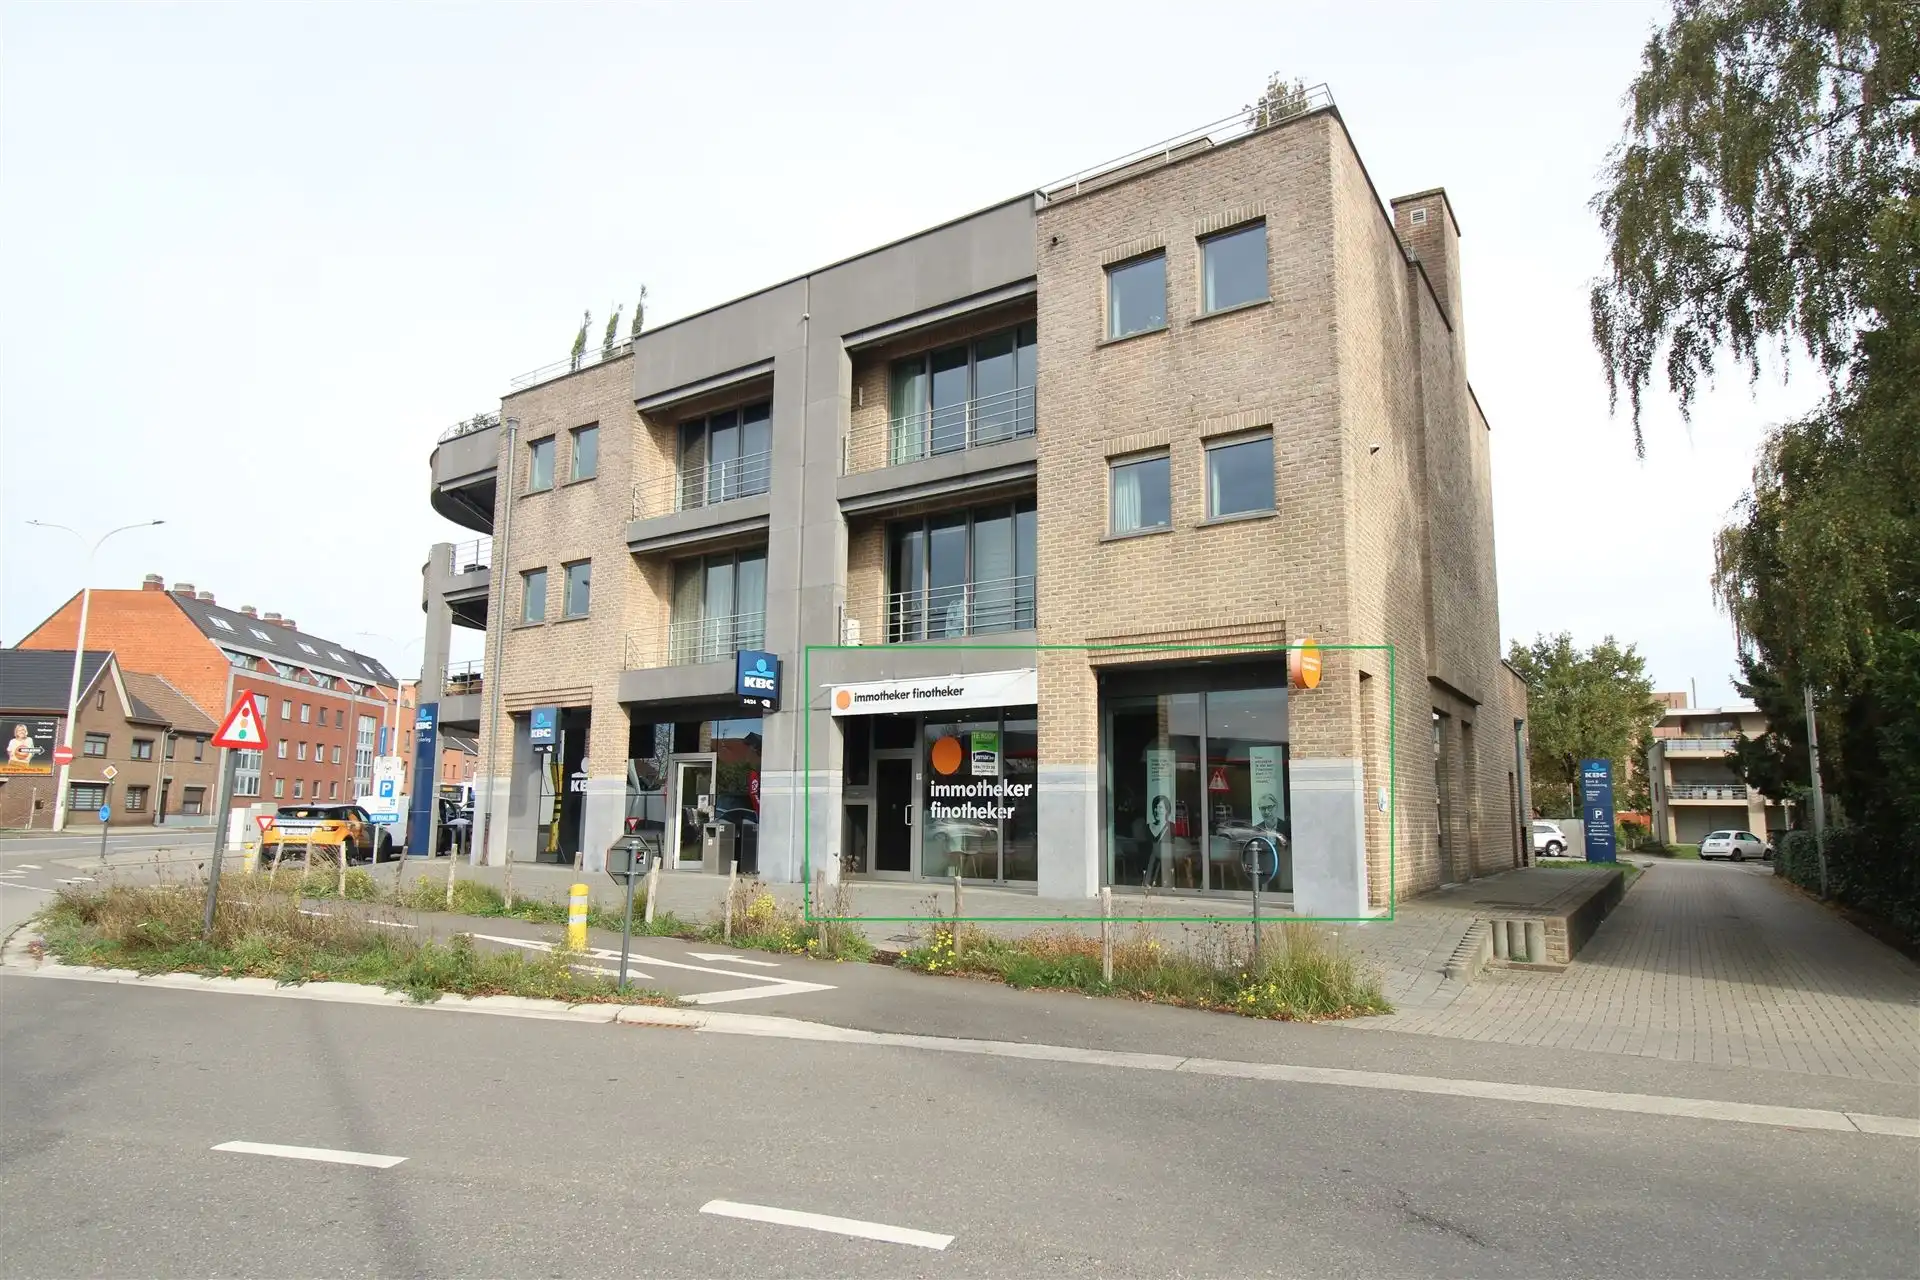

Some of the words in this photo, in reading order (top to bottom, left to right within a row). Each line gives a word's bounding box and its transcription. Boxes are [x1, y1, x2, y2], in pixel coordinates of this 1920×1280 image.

[744, 676, 774, 690] KBC
[854, 690, 910, 702] immotheker
[912, 685, 964, 699] finotheker
[531, 728, 551, 738] KBC
[569, 780, 588, 792] KB
[930, 779, 1032, 797] immotheker
[930, 801, 1015, 819] finotheker
